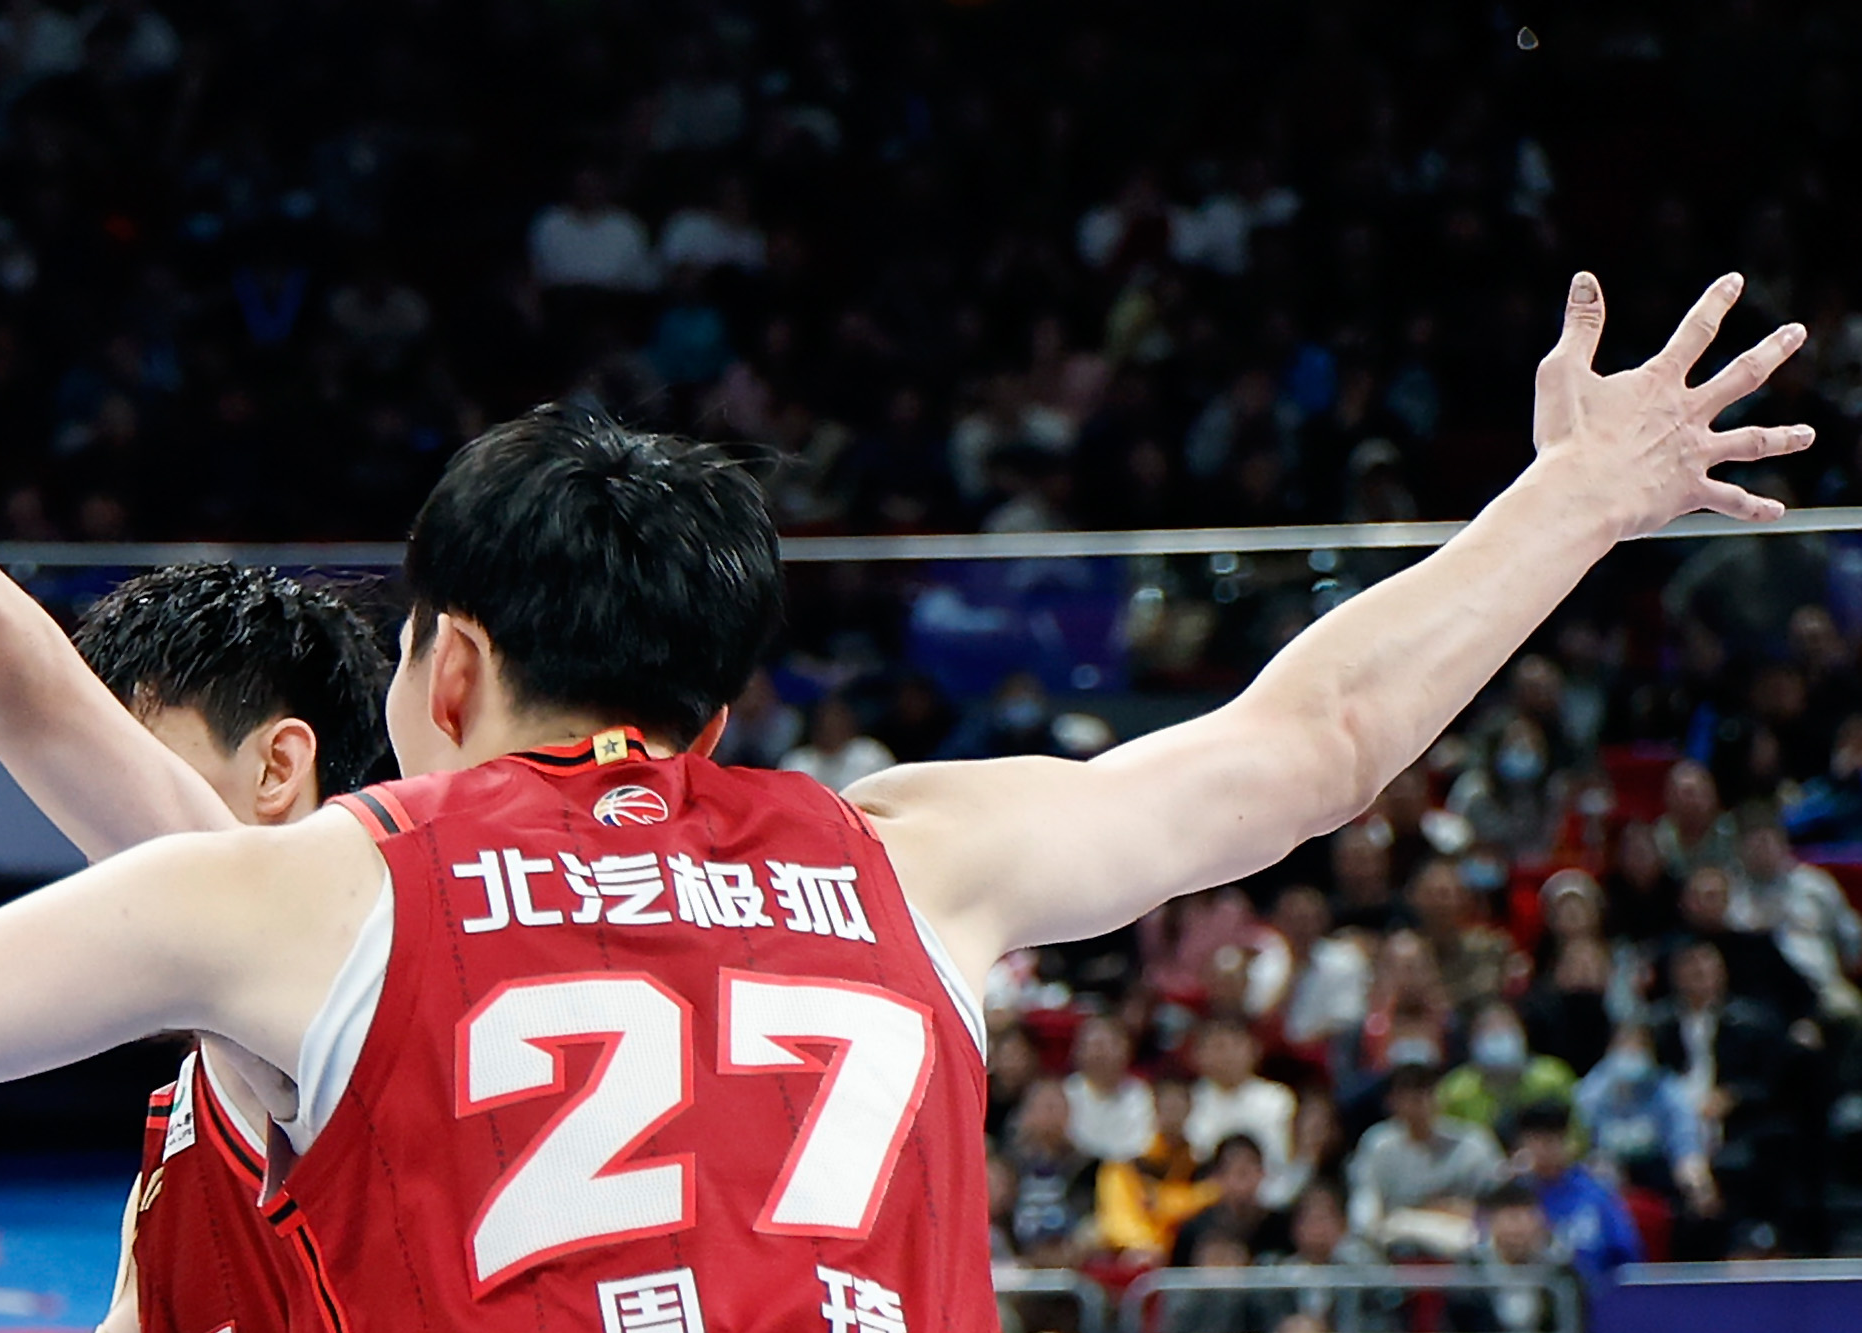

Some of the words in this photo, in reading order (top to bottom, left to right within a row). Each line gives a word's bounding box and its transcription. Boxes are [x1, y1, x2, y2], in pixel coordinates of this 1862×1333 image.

[452, 847, 876, 944] 北汽极狐
[455, 966, 935, 1301] 27
